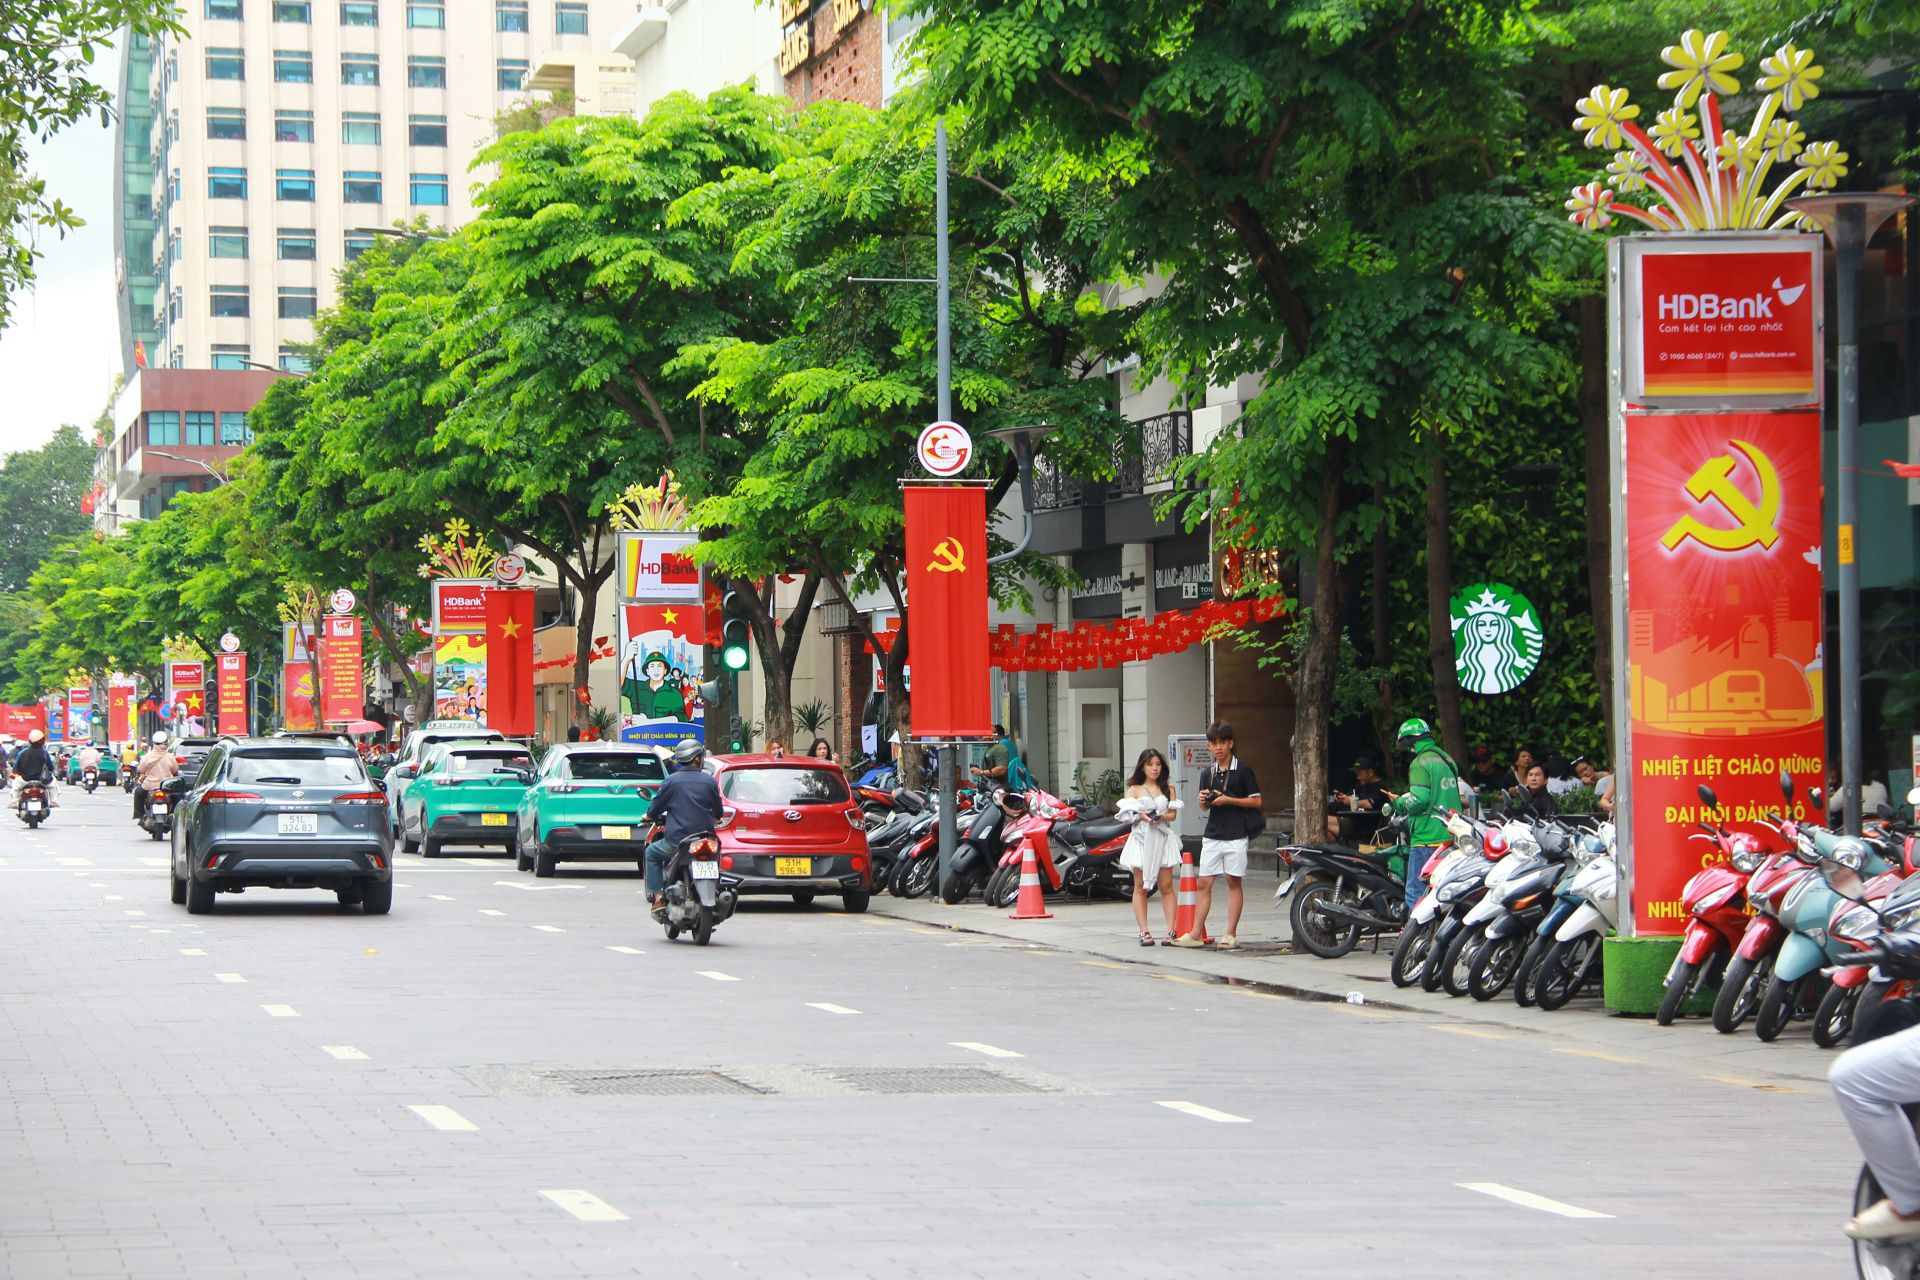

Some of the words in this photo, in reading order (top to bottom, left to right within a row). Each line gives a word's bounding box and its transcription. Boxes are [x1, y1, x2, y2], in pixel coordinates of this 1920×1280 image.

[1658, 293, 1773, 320] HDBank
[1659, 323, 1680, 333] Cam
[1683, 322, 1700, 333] kết
[1738, 323, 1757, 332] cao
[640, 562, 697, 575] HDBank
[444, 597, 482, 606] HDBank
[1642, 754, 1689, 781] NHIỆT
[1693, 754, 1723, 781] LIỆT
[1727, 753, 1775, 775] CHÀO
[1779, 753, 1822, 774] MỪNG
[1665, 806, 1694, 828] ĐẠI
[1700, 801, 1730, 828] HỘI
[1735, 800, 1781, 823] ĐẢNG
